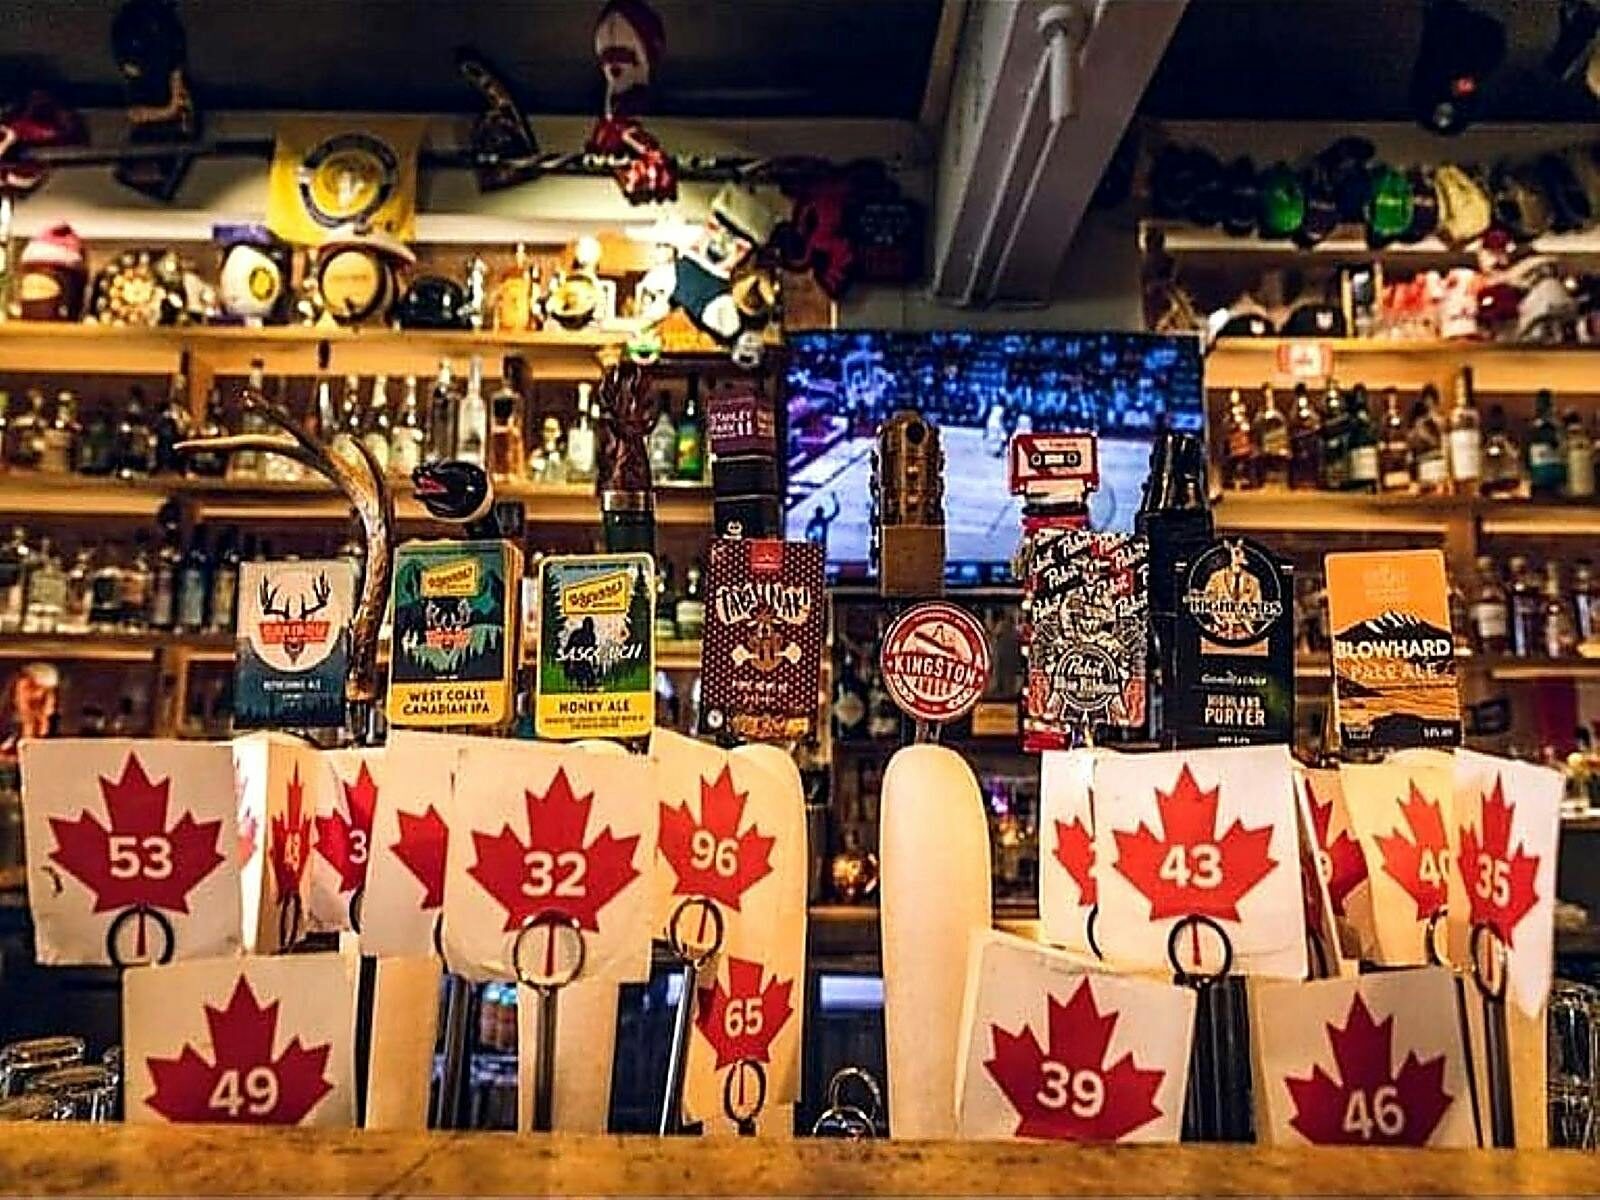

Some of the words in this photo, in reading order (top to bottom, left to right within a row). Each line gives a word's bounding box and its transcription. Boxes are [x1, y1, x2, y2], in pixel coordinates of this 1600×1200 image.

[1335, 639, 1451, 659] BLOWHARD
[894, 655, 977, 688] KINGSTON
[1351, 664, 1399, 680] PALE
[1400, 662, 1439, 678] ALE
[403, 702, 467, 716] CANADIAN
[471, 701, 490, 714] IPA
[409, 690, 442, 702] WEST
[447, 688, 485, 701] COAST
[559, 700, 603, 714] HONEY
[609, 698, 630, 712] ALE
[1204, 707, 1265, 726] PORTER
[109, 837, 173, 879] 53
[521, 851, 587, 897] 32
[691, 831, 739, 877] 96
[1159, 844, 1223, 889] 43
[1475, 855, 1512, 908] 35
[725, 999, 763, 1037] 65
[208, 1067, 280, 1116] 49
[1037, 1060, 1105, 1118] 39
[1341, 1085, 1404, 1139] 46
